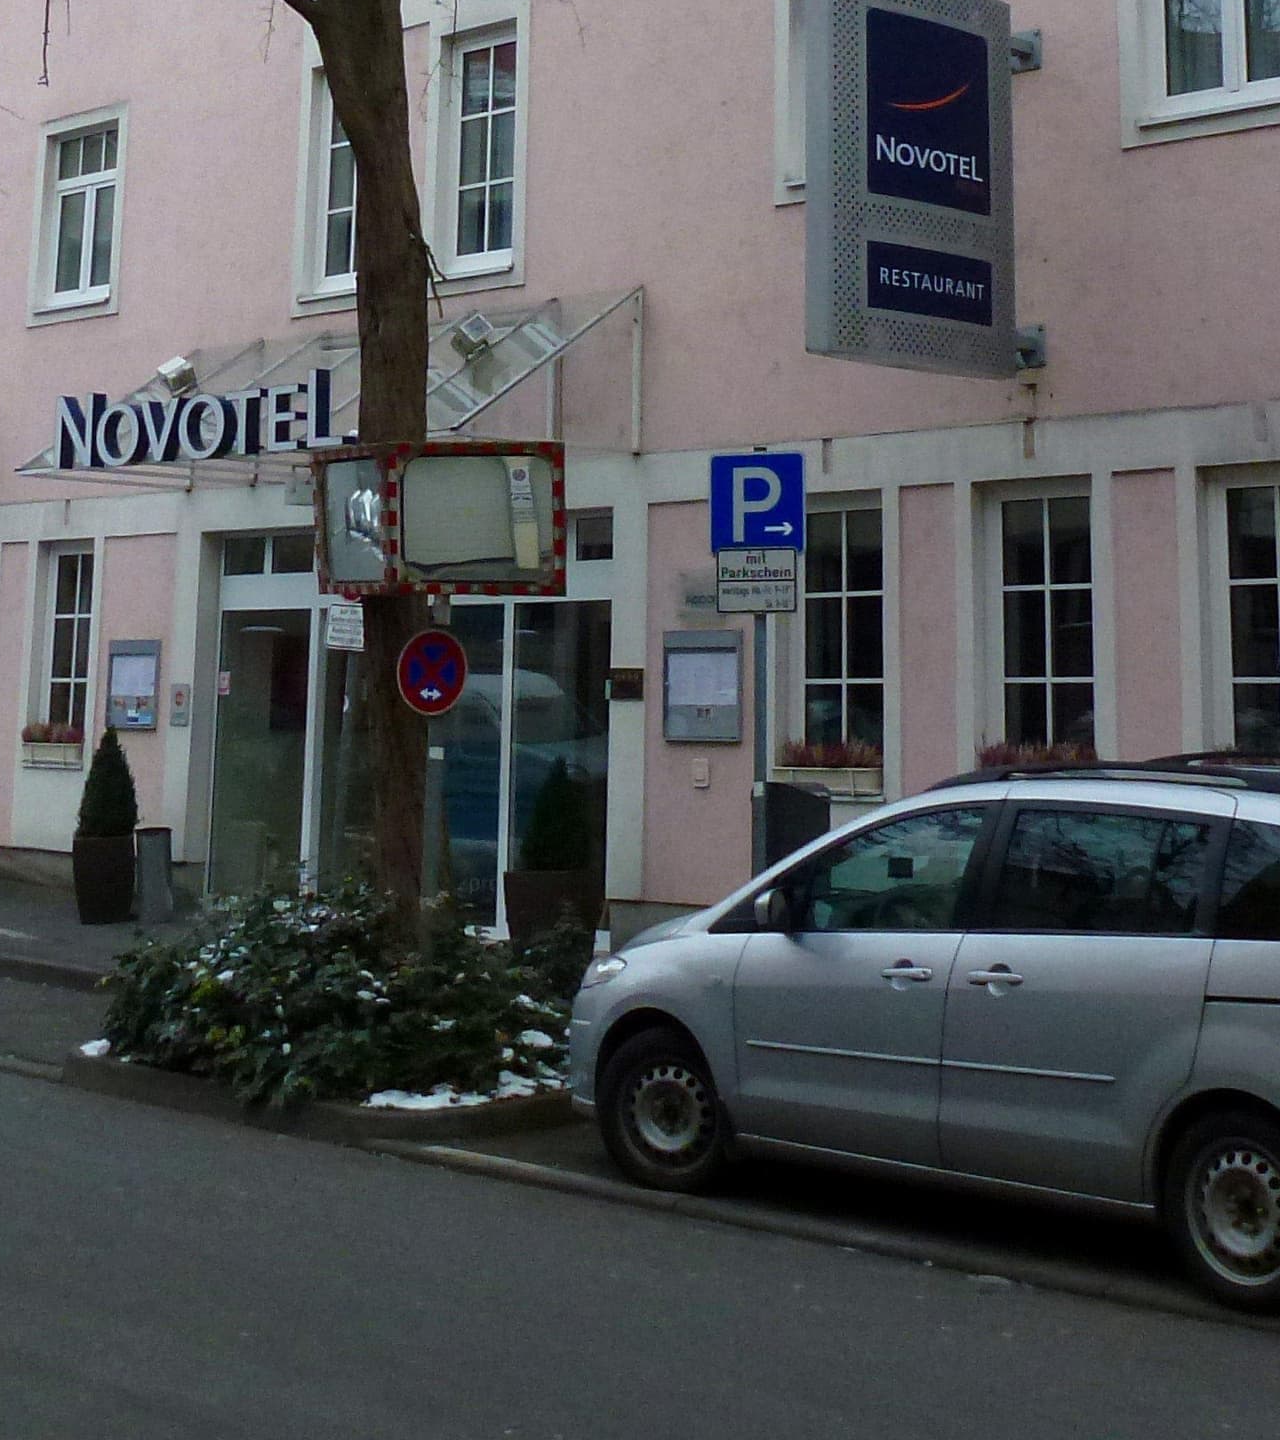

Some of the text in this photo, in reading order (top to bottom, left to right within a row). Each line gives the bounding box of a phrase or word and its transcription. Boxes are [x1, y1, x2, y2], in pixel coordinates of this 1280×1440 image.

[876, 134, 983, 183] NOVOTEL
[879, 266, 984, 300] RESTAURANT
[56, 368, 355, 469] NOVOTEL
[732, 466, 781, 542] P
[721, 566, 791, 578] Parkschein
[746, 550, 766, 564] mit
